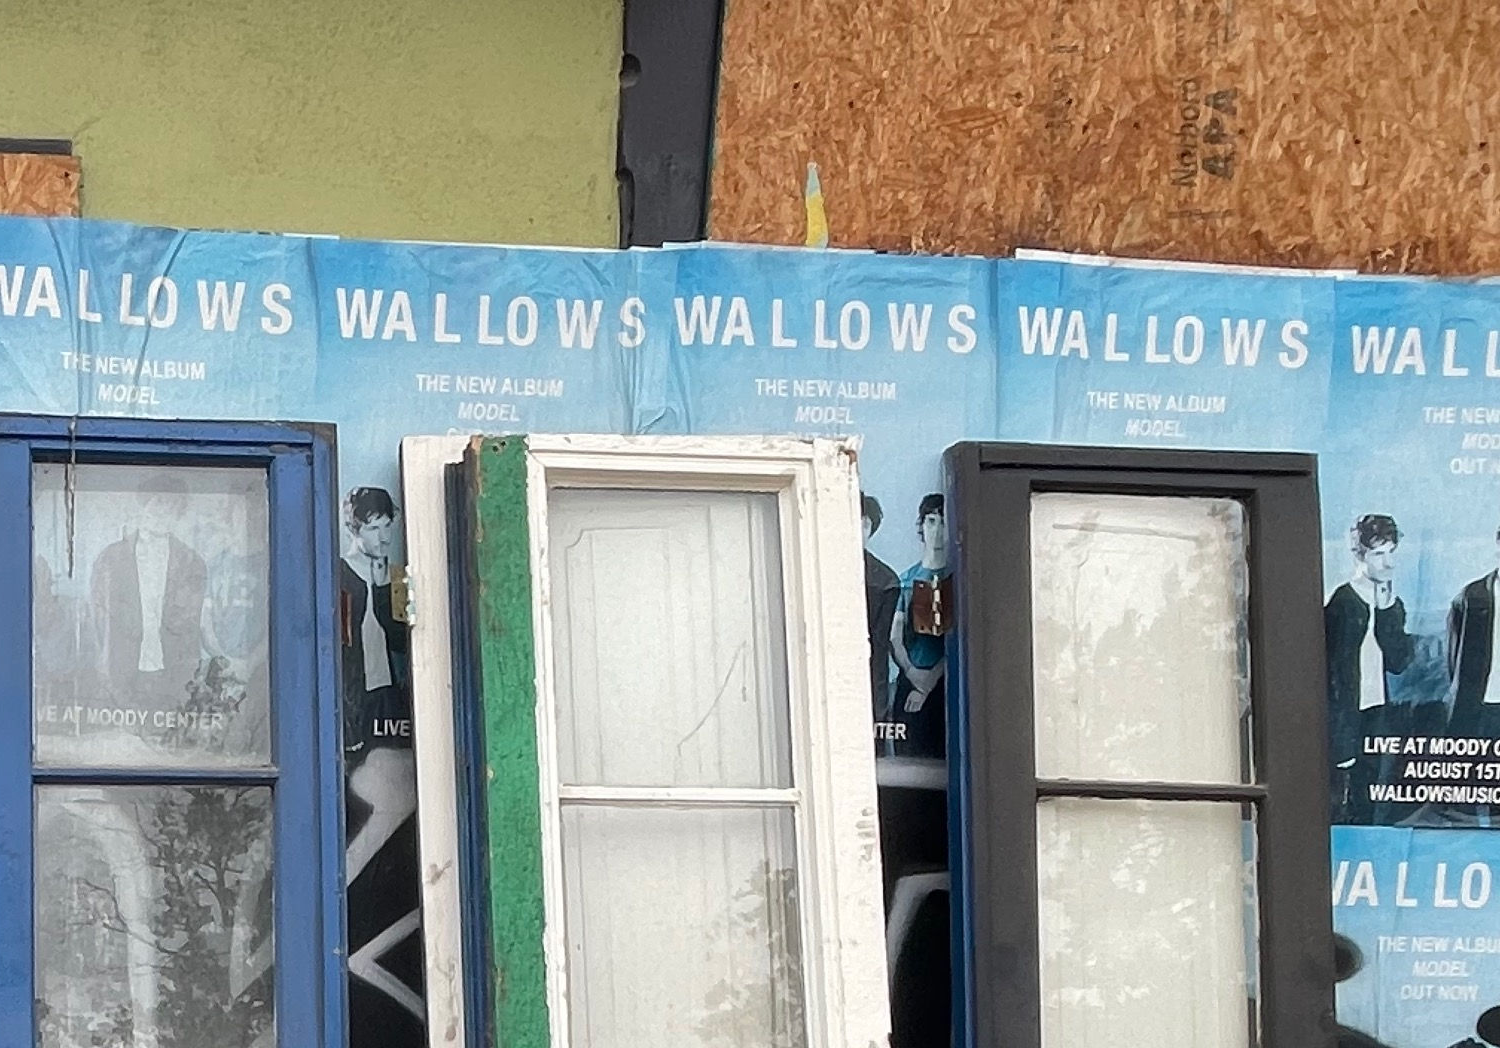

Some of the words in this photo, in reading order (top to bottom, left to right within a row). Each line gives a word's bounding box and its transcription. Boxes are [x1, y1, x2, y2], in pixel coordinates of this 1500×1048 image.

[336, 287, 646, 349] WALLOWS
[674, 295, 977, 353] WALLOWS
[1018, 306, 1309, 369] WALLOWS
[1352, 325, 1500, 378] WALL
[60, 351, 91, 373] THE
[95, 354, 138, 376] NEW
[140, 359, 206, 380] ALBUM
[95, 383, 160, 405] MODEL
[416, 374, 451, 393] THE
[456, 375, 497, 395] NEW
[501, 377, 563, 397] ALBUM
[754, 378, 788, 397] THE
[793, 380, 833, 398] NEW
[837, 381, 896, 400] ALBUM
[457, 402, 520, 422] MODEL
[1087, 391, 1118, 409] THE
[1123, 393, 1161, 411] NEW
[1166, 395, 1226, 414] ALBUM
[795, 406, 854, 425] MODEL
[1423, 406, 1458, 424] THE
[1124, 418, 1187, 438] MODEL
[1450, 457, 1486, 475] OUT
[153, 711, 223, 730] CENTER
[373, 718, 411, 737] LIVE
[1364, 736, 1401, 754] LIVE
[1404, 737, 1427, 754] AT
[1429, 738, 1491, 755] MOODY
[1404, 761, 1473, 779] AUGUST
[1369, 785, 1500, 804] WALLOWSMUSIC
[1378, 936, 1407, 952] THE
[1411, 937, 1449, 953] NEW
[1453, 937, 1500, 954] ALBU
[1412, 960, 1470, 978] MODEL
[1401, 984, 1437, 1000] OUT
[1439, 985, 1480, 1002] NOW
